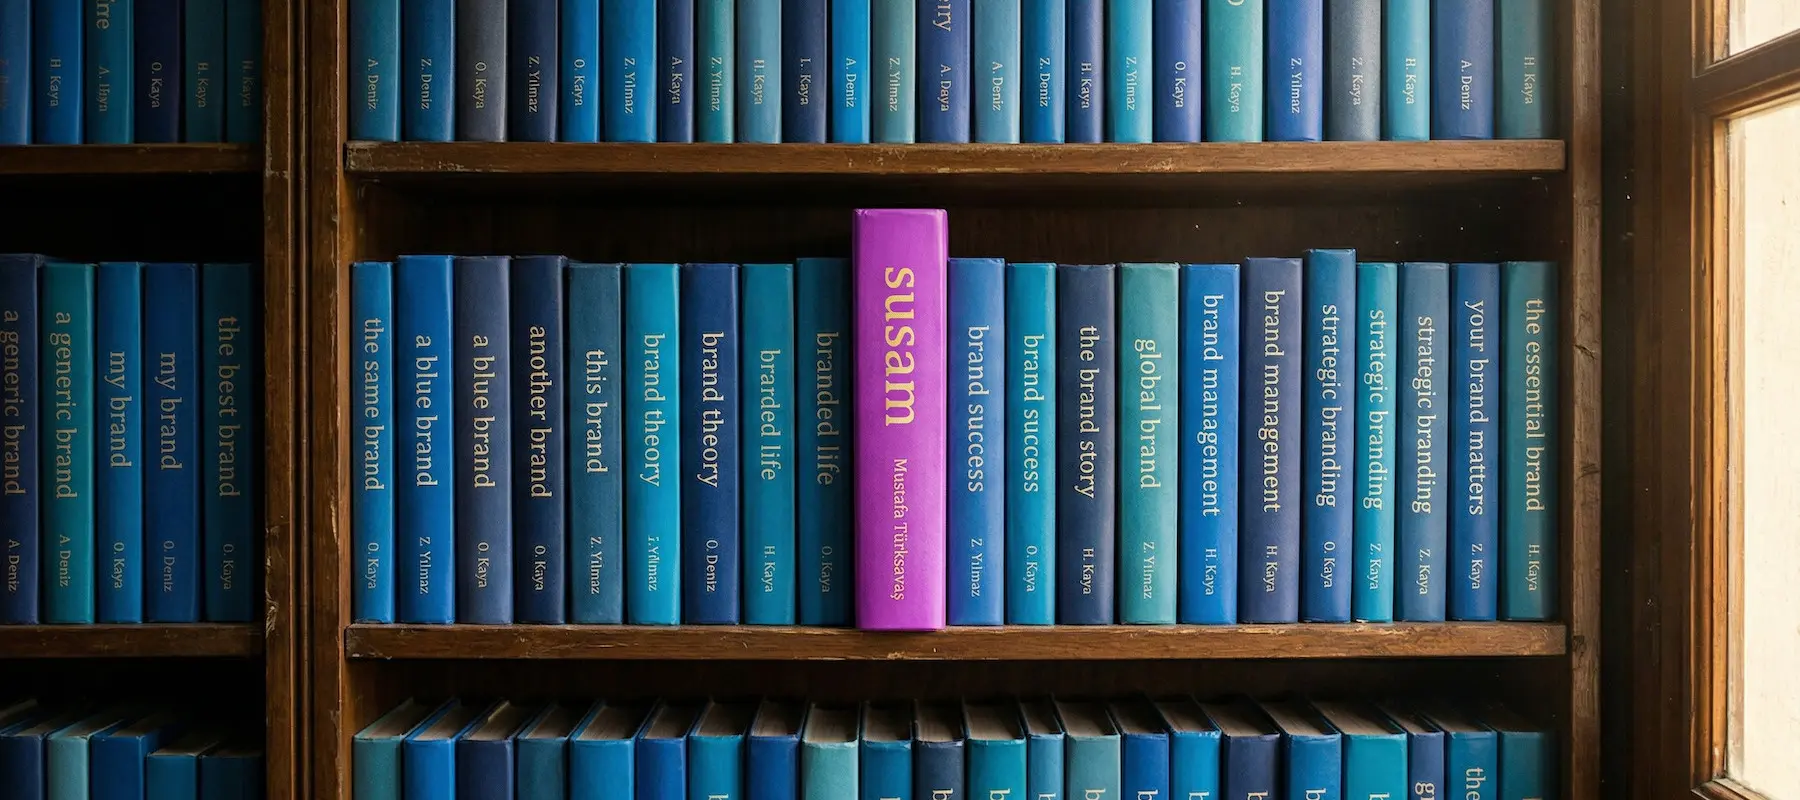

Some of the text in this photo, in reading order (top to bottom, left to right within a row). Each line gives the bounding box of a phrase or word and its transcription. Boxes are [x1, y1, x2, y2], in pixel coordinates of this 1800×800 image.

[148, 78, 163, 108] Kaya
[367, 74, 379, 110] Deniz
[420, 74, 433, 110] Deniz
[472, 78, 487, 109] Kaya
[571, 75, 586, 106] Kaya
[668, 72, 683, 104] Kaya
[845, 73, 857, 108] Deniz
[991, 76, 1004, 111] Deniz
[1039, 72, 1051, 107] Deniz
[1077, 78, 1093, 109] Kaya
[1171, 77, 1186, 108] Kaya
[1227, 82, 1242, 113] Kaya
[1348, 72, 1364, 106] Kaya
[1401, 74, 1417, 105] Kaya
[1461, 75, 1473, 110] Deniz
[1520, 73, 1536, 105] Kaya
[884, 267, 916, 426] susam
[0, 310, 27, 495] a generic brand
[49, 311, 78, 499] a generic brand
[103, 351, 133, 468] my brand
[153, 351, 183, 471] my brand
[217, 316, 241, 497] the best brand
[364, 317, 385, 491] the same brand
[415, 334, 439, 487] a blue brand
[472, 334, 496, 488] a blue brand
[529, 326, 553, 498] another brand
[585, 349, 609, 474] this brand
[639, 333, 666, 487] brand theory
[696, 331, 725, 488] brand theory
[816, 331, 840, 485] branded life
[967, 324, 990, 492] brand success
[1023, 333, 1045, 493] brand success
[1073, 325, 1101, 499] the brand story
[1134, 338, 1162, 489] global brand
[1196, 293, 1224, 518] brand management
[1257, 289, 1286, 513] brand management
[1315, 304, 1343, 507] strategic branding
[1362, 309, 1389, 510] strategic branding
[1411, 316, 1437, 514] strategic branding
[1464, 300, 1490, 516] your brand matters
[1525, 298, 1546, 511] the essential brand
[760, 444, 782, 481] life
[889, 458, 909, 601] Mustafa Türksavaş
[7, 554, 20, 592] Deniz
[59, 549, 72, 588] Deniz
[110, 557, 126, 589] Kaya
[163, 556, 176, 593] Deniz
[219, 559, 235, 590] Kaya
[364, 558, 380, 589] Kaya
[474, 557, 490, 588] Kaya
[531, 560, 547, 591] Kaya
[706, 554, 719, 592] Deniz
[760, 561, 776, 593] Kaya
[818, 561, 833, 593] Kaya
[1022, 561, 1039, 593] Kaya
[1079, 564, 1095, 595] Kaya
[1201, 564, 1217, 596] Kaya
[1262, 561, 1278, 593] Kaya
[1320, 557, 1336, 588] Kaya
[1366, 558, 1382, 590] Kaya
[1415, 564, 1431, 595] Kaya
[1467, 559, 1484, 590] Kaya
[1524, 560, 1540, 591] Kaya
